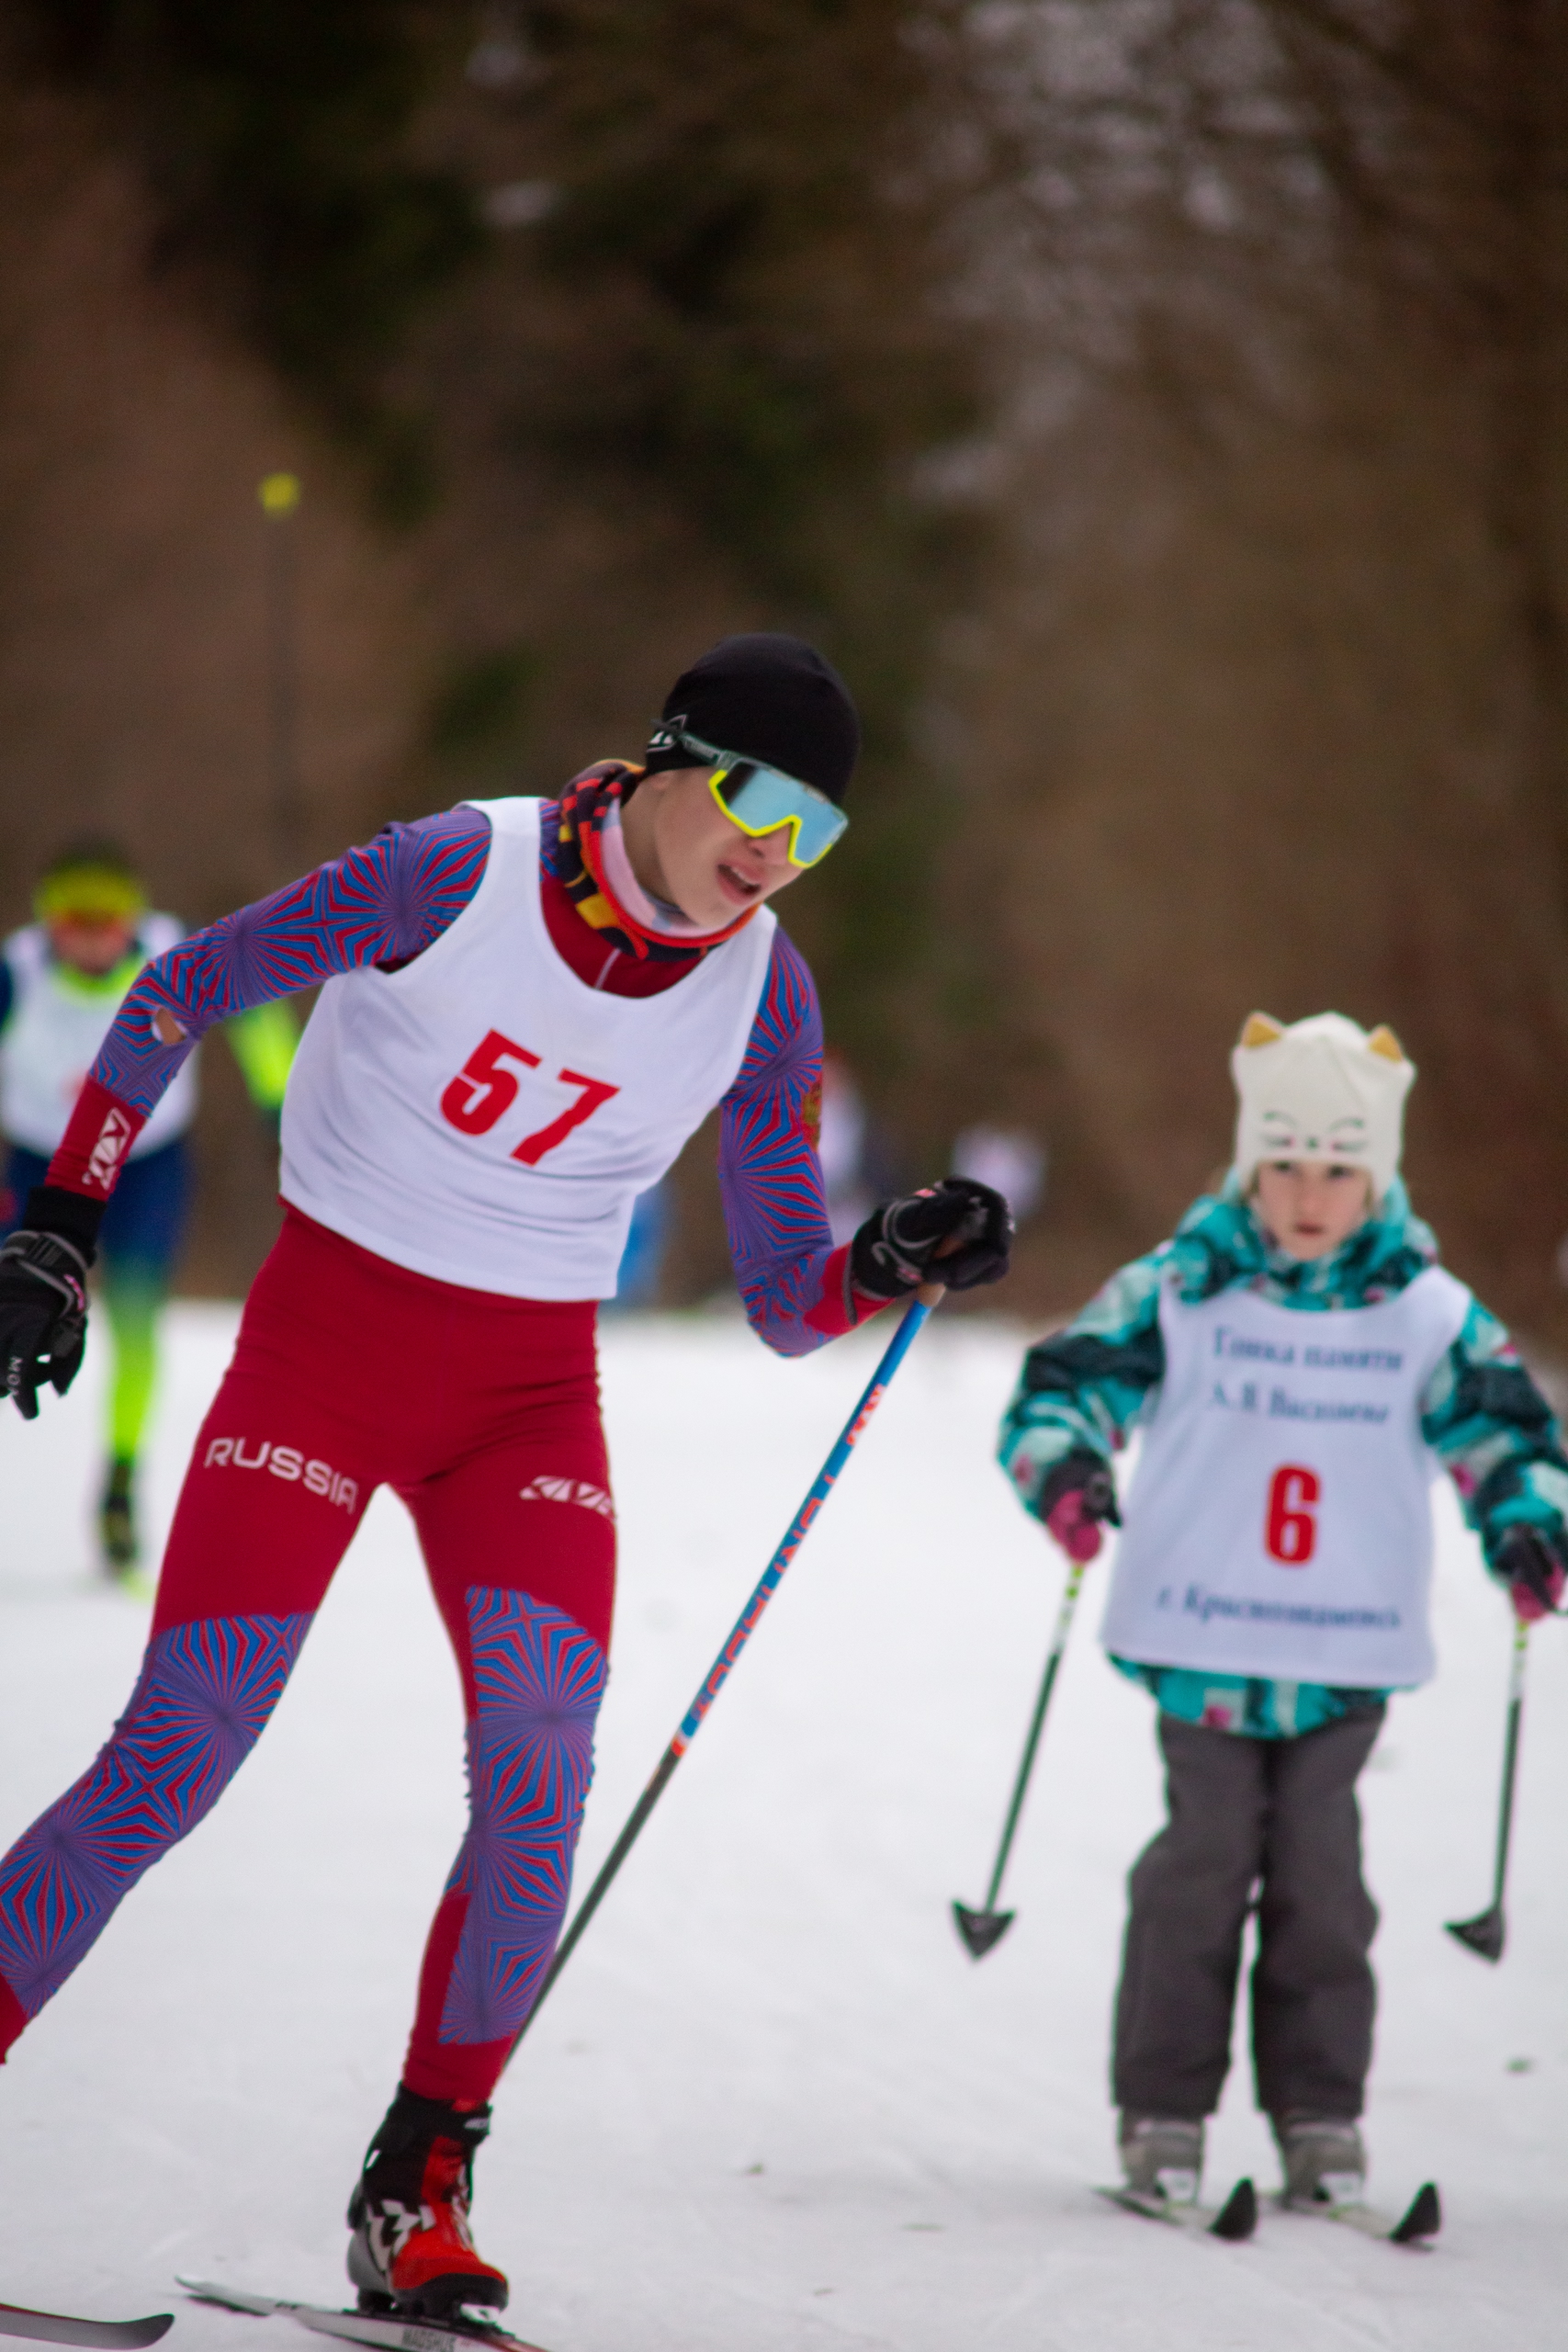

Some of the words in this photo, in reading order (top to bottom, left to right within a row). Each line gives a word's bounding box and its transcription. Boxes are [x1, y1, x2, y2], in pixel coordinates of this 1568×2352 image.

[441, 1027, 622, 1168] 57
[203, 1436, 360, 1516] RUSSIA
[1264, 1462, 1323, 1568] 6
